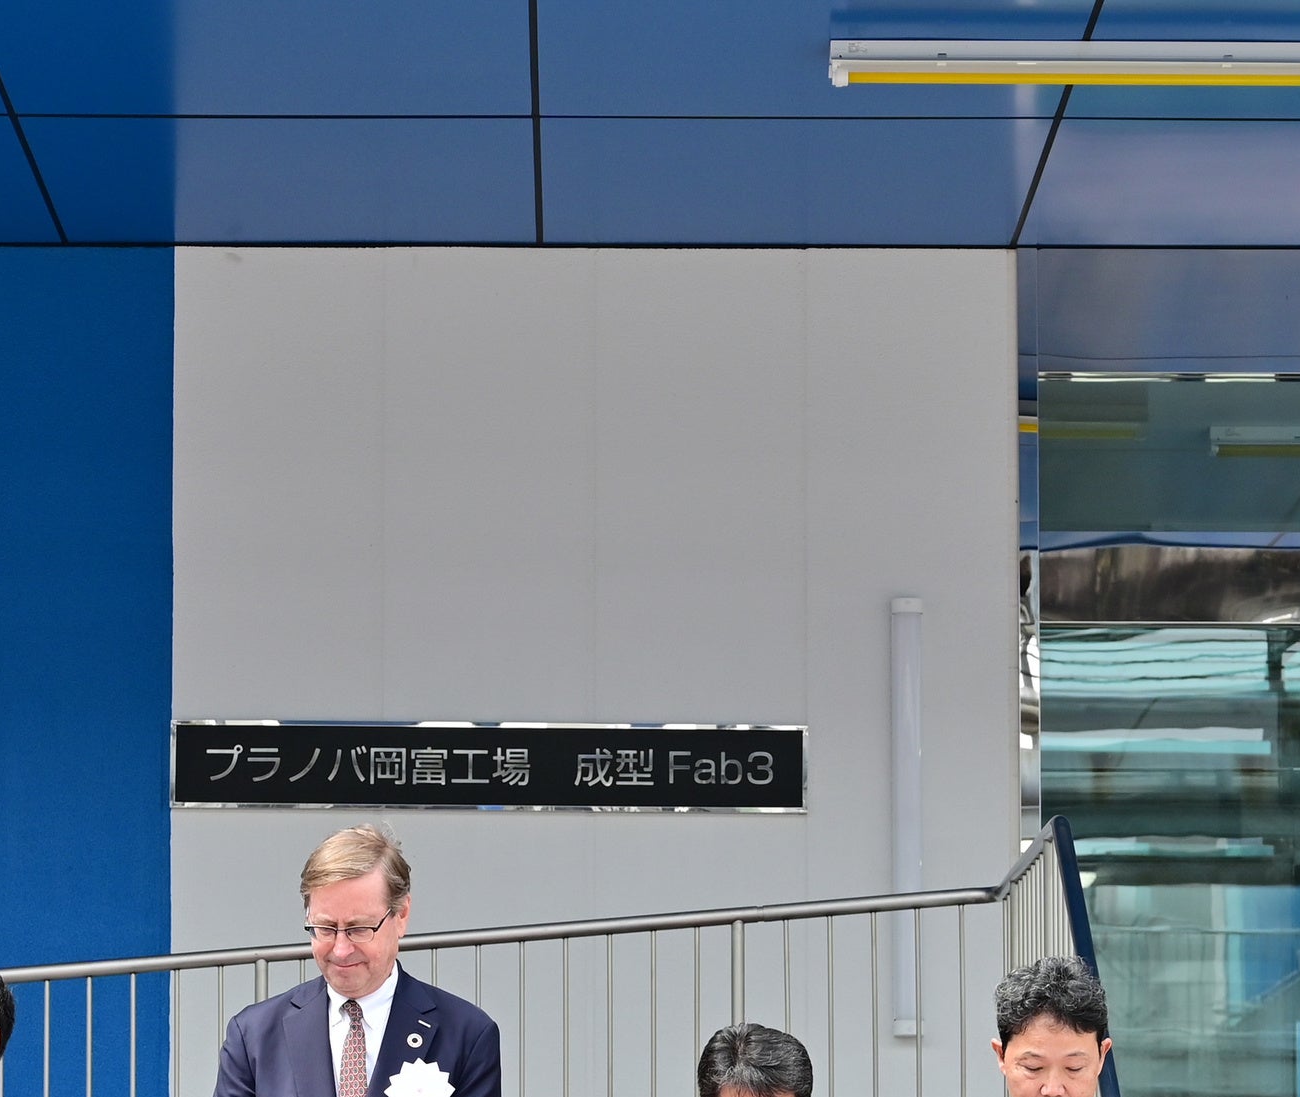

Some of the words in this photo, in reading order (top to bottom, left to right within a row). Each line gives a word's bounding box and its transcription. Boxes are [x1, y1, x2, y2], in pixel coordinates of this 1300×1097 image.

[205, 744, 531, 786] プラノバ岡富工場
